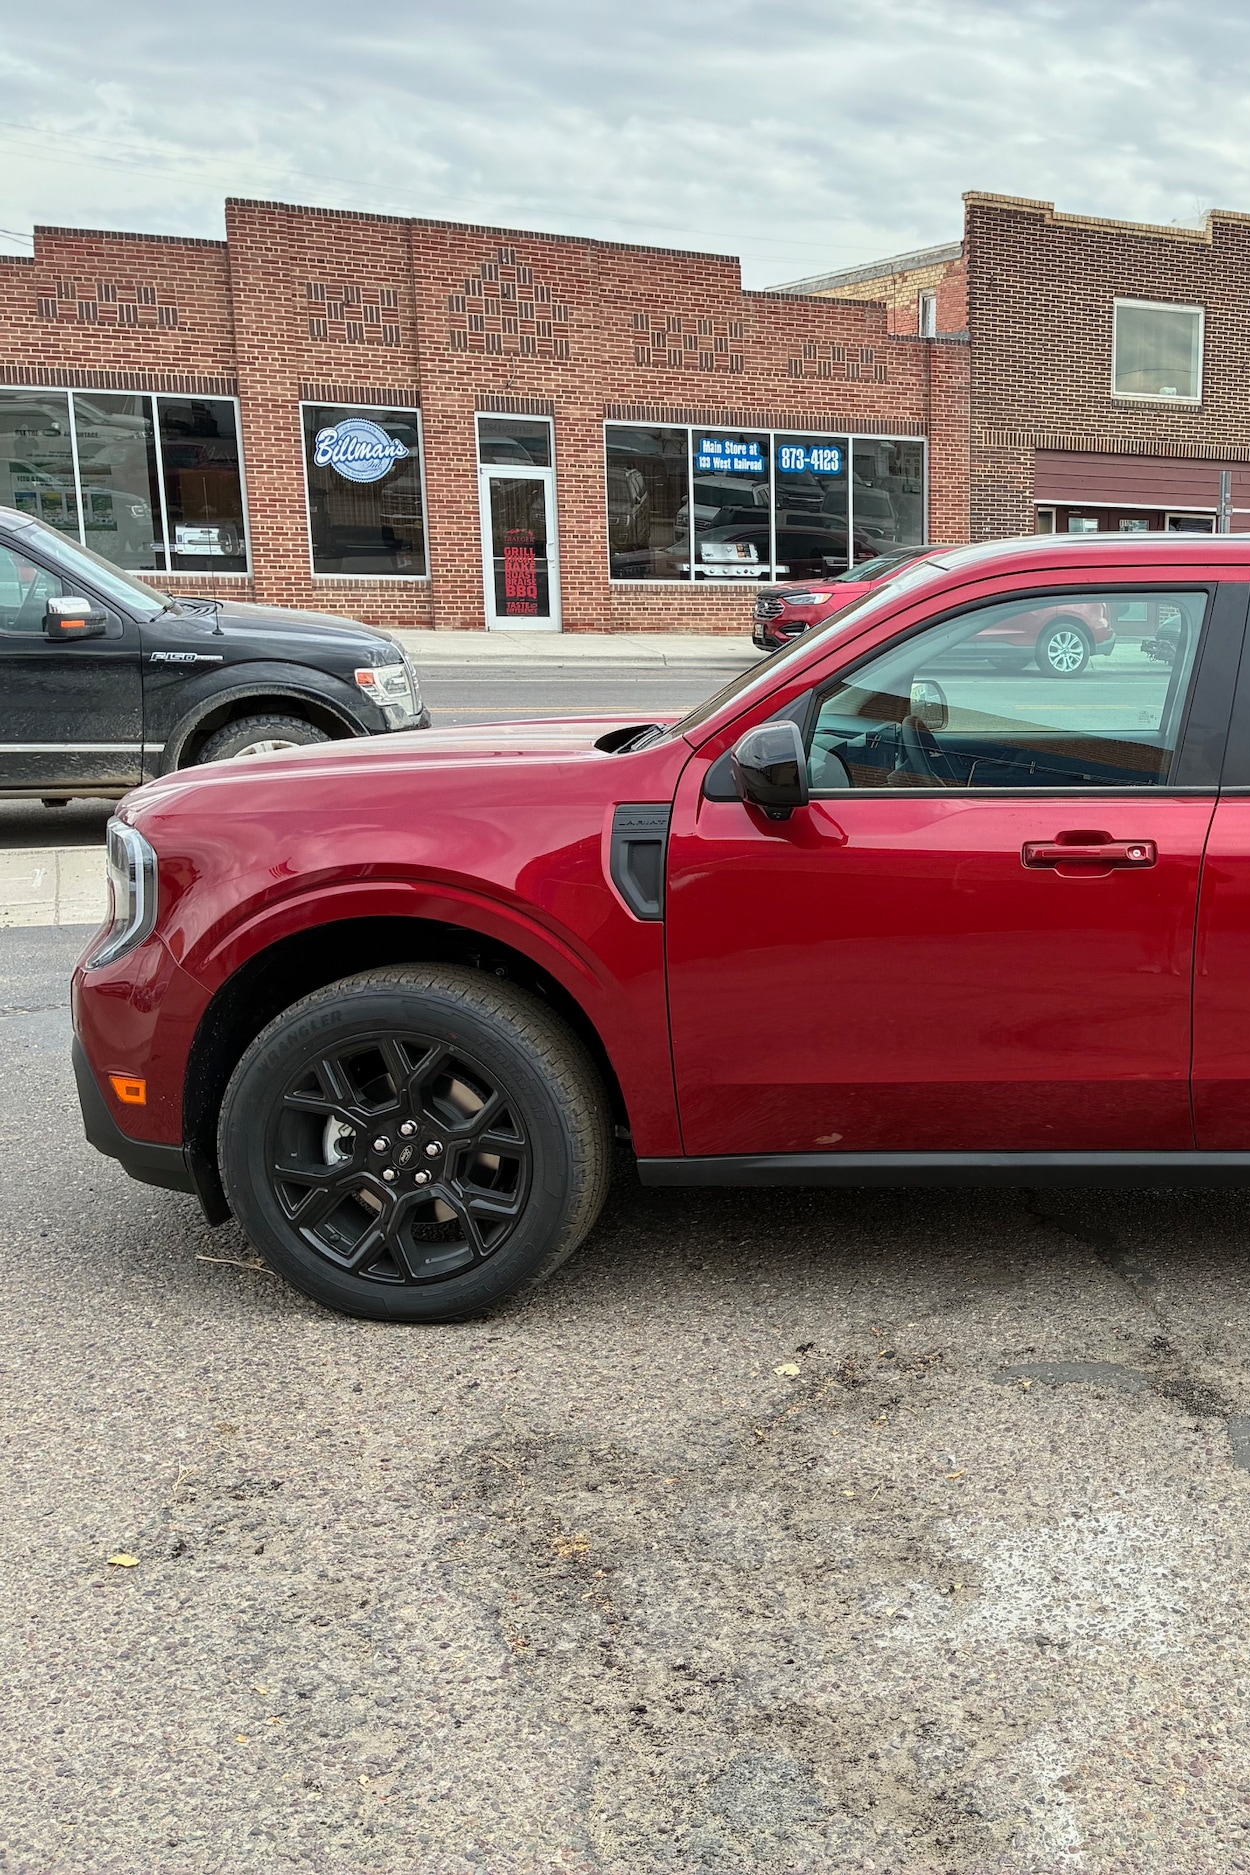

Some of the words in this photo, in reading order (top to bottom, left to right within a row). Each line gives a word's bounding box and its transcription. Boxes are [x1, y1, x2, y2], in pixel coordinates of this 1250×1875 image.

[316, 428, 407, 463] Billman's
[703, 440, 722, 453] Main
[725, 441, 746, 455] Store
[749, 443, 758, 456] at
[699, 456, 711, 468] 133
[713, 457, 731, 469] West
[734, 458, 762, 471] Railroad
[781, 447, 839, 471] 873-4123
[504, 547, 535, 556] GRILL
[505, 562, 536, 572] BAKE
[505, 571, 536, 579] ROAST
[506, 585, 537, 599] BBQ
[257, 1010, 342, 1073] WRANGLER
